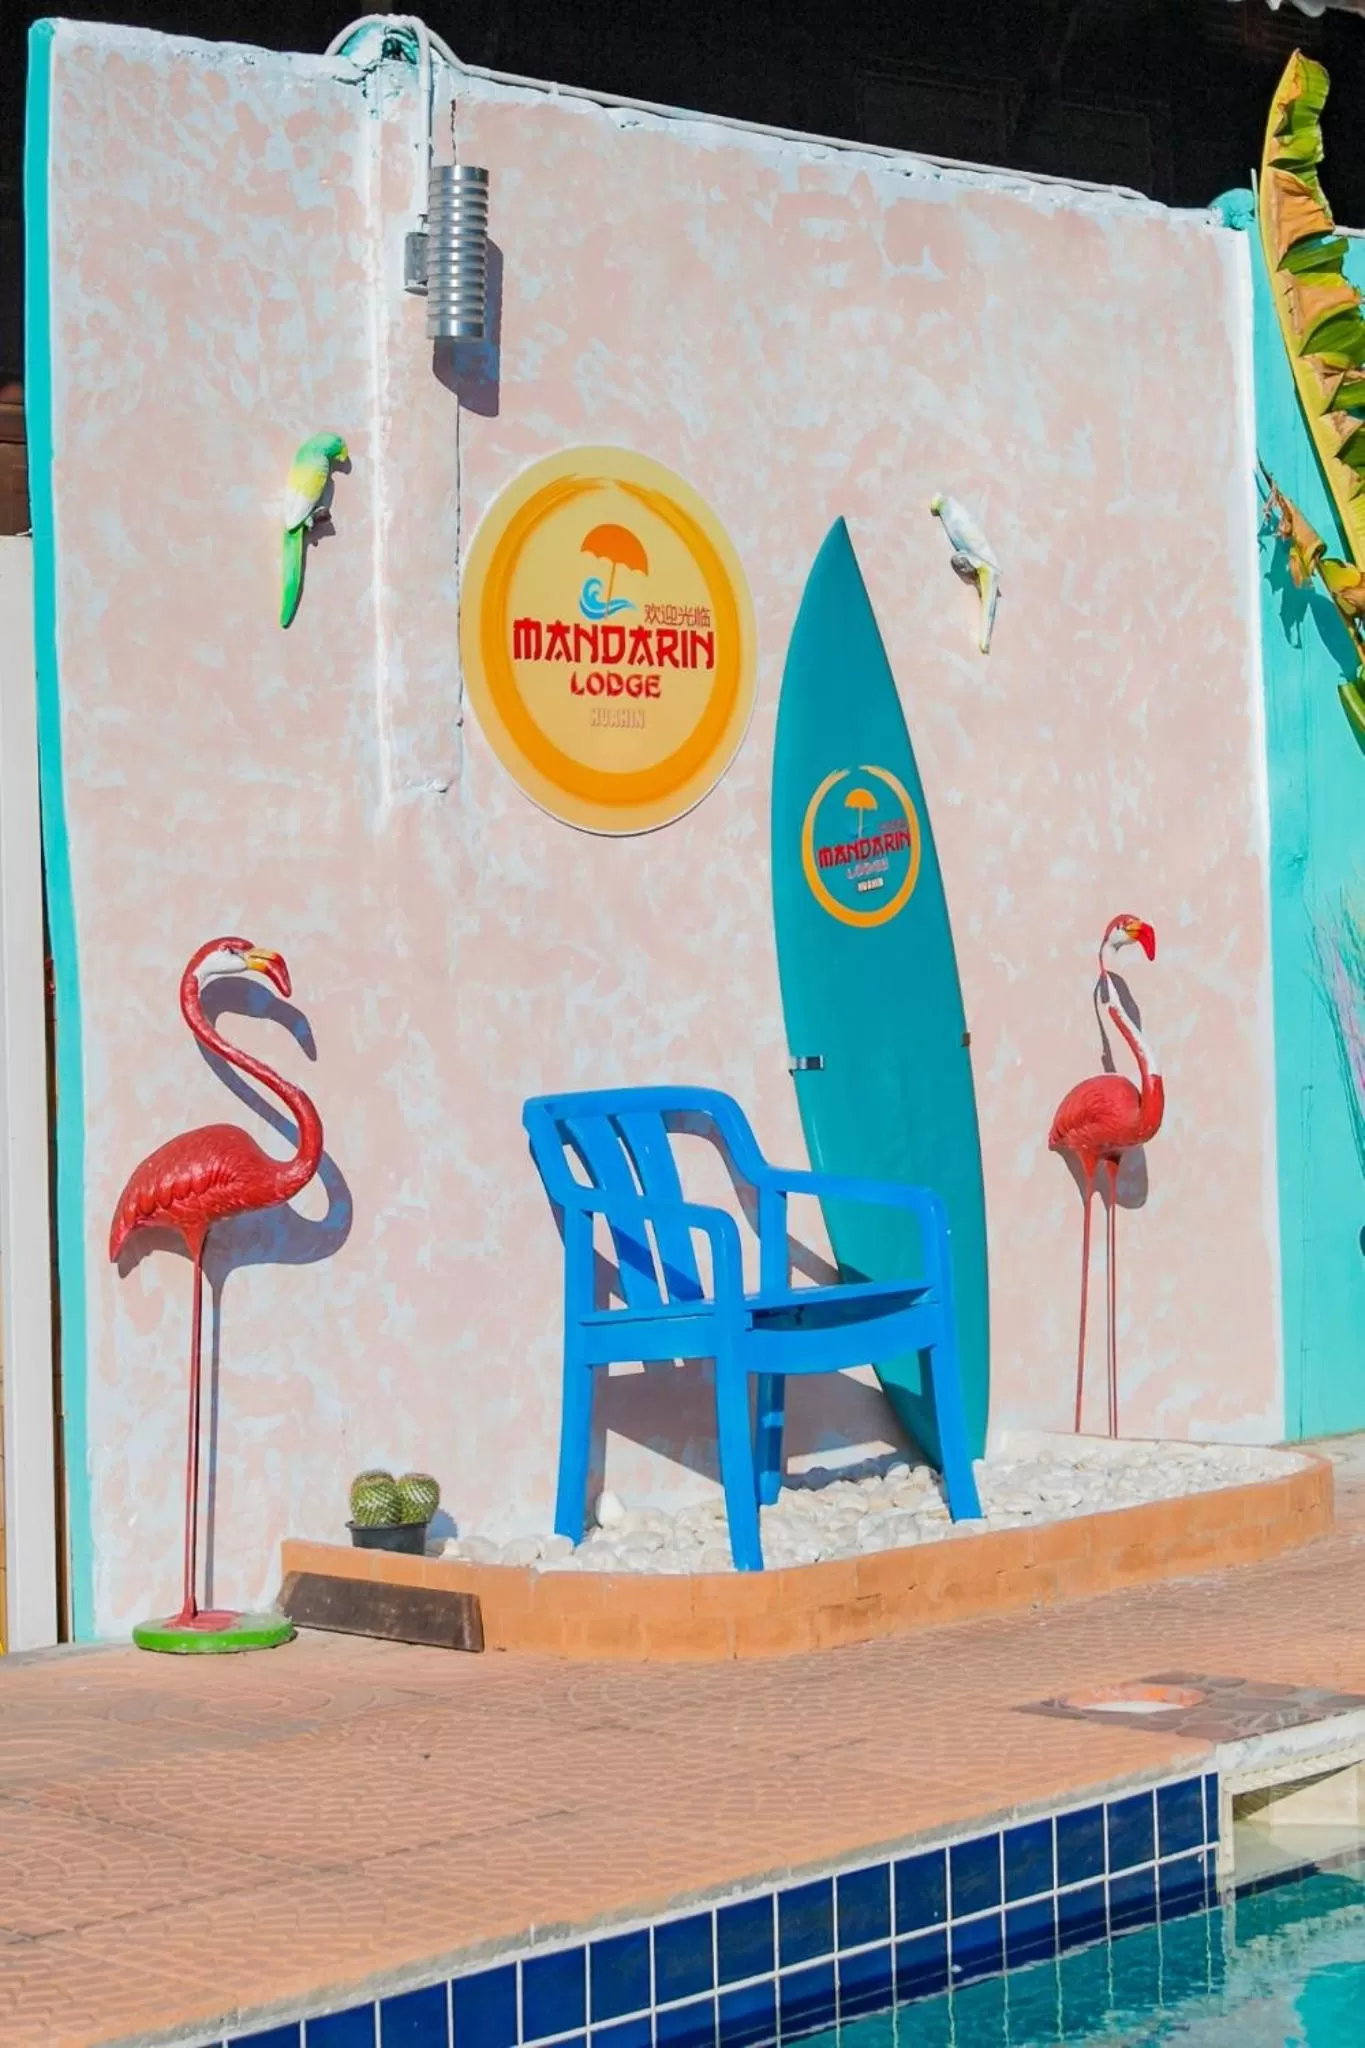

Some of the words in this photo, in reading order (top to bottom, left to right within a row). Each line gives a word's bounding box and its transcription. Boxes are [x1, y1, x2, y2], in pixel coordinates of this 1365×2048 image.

[643, 603, 711, 628] 欢迎光临
[513, 617, 715, 669] MANDARIN
[570, 671, 661, 698] LODGE
[818, 830, 911, 868] MANDARIN
